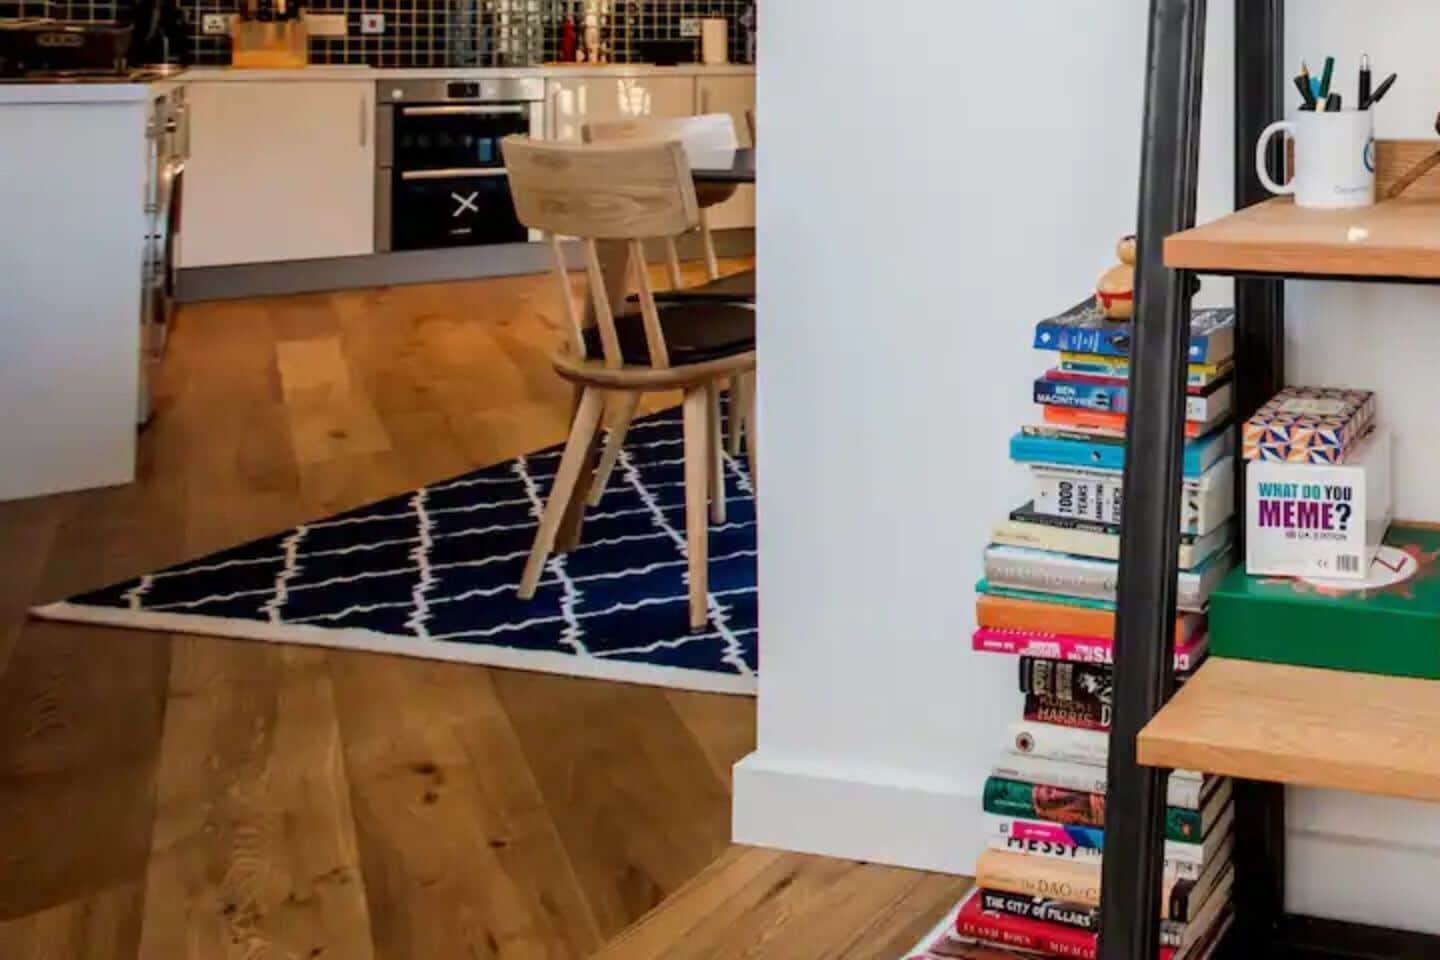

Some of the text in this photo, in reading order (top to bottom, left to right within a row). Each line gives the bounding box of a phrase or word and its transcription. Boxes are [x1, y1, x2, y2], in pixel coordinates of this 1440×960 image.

[1058, 481, 1073, 513] 1000
[1258, 482, 1352, 501] WHAT DO YOU
[1258, 499, 1352, 531] MEME?
[985, 896, 1092, 927] THE CITY of PILLARS
